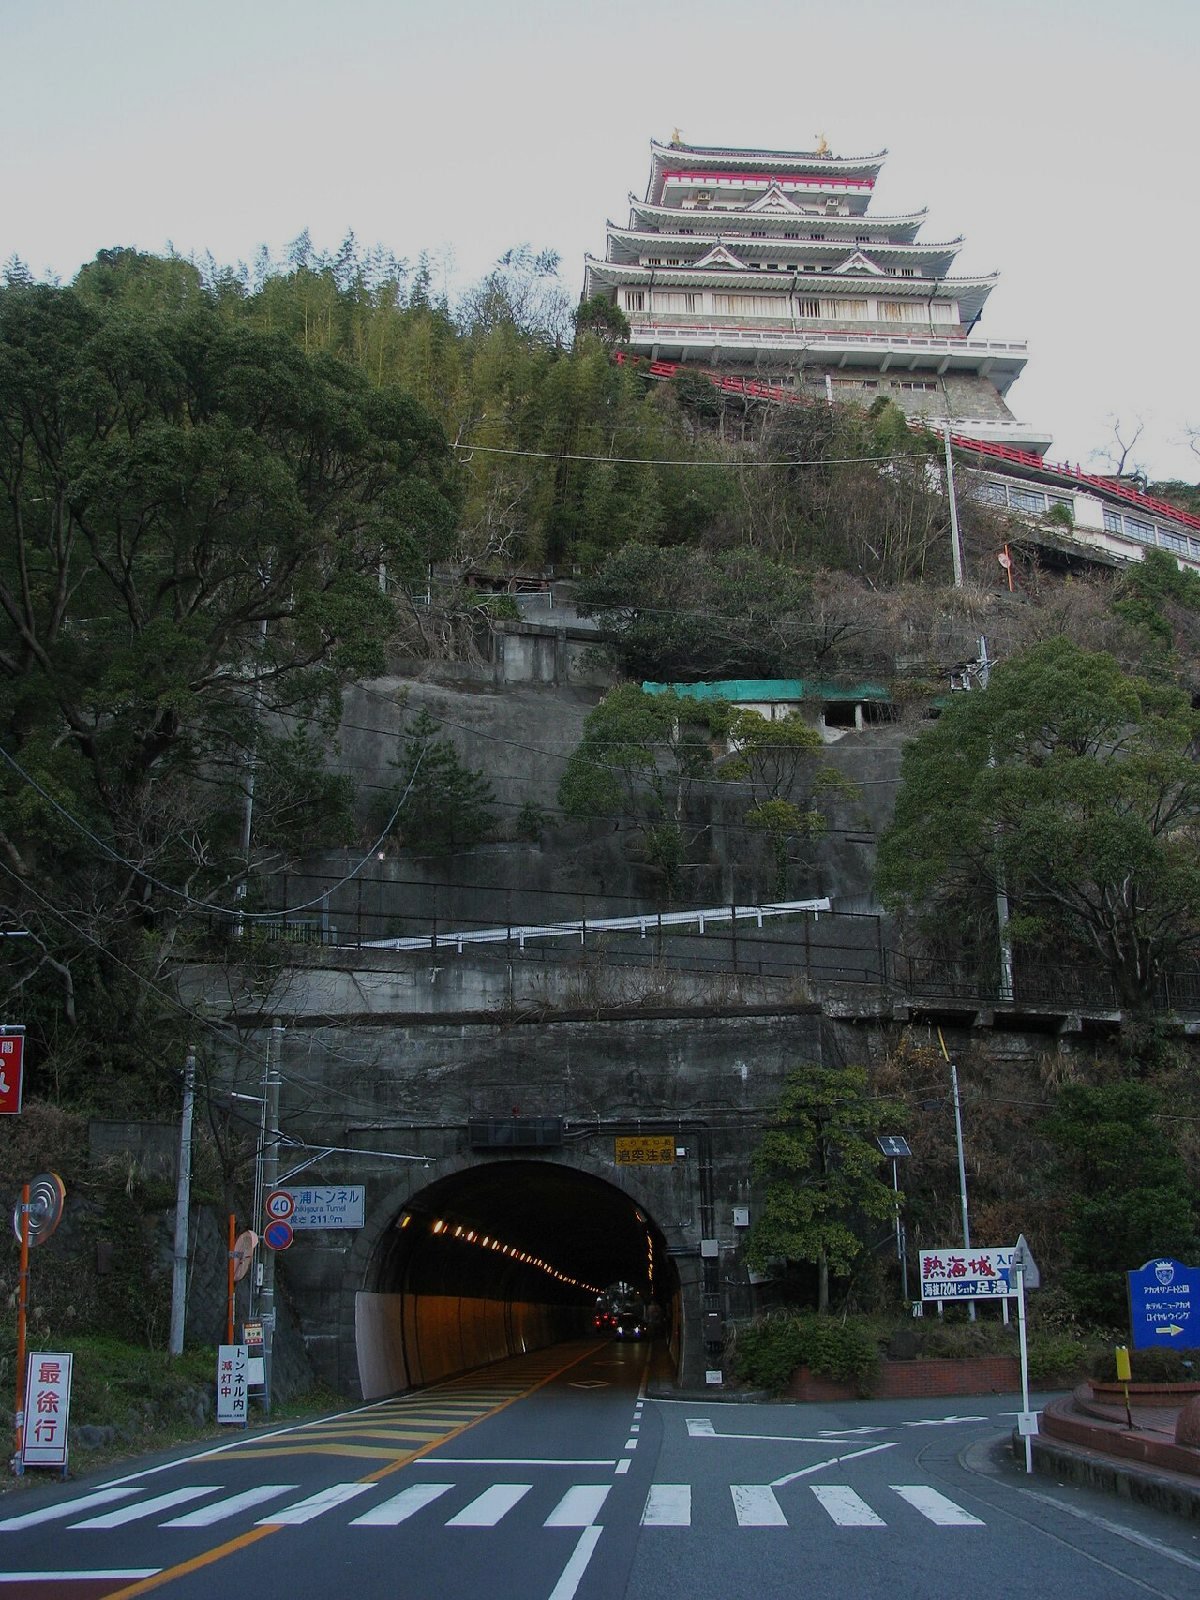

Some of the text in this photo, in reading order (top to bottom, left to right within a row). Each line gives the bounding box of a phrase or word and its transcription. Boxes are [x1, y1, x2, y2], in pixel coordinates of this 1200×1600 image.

[273, 1200, 289, 1213] 40
[923, 1255, 996, 1280] 熱海城
[1145, 1301, 1191, 1311] ホテルニューアカオ
[220, 1360, 233, 1398] 減灯中
[233, 1348, 245, 1411] トンネル内
[34, 1362, 61, 1443] 最徐行
